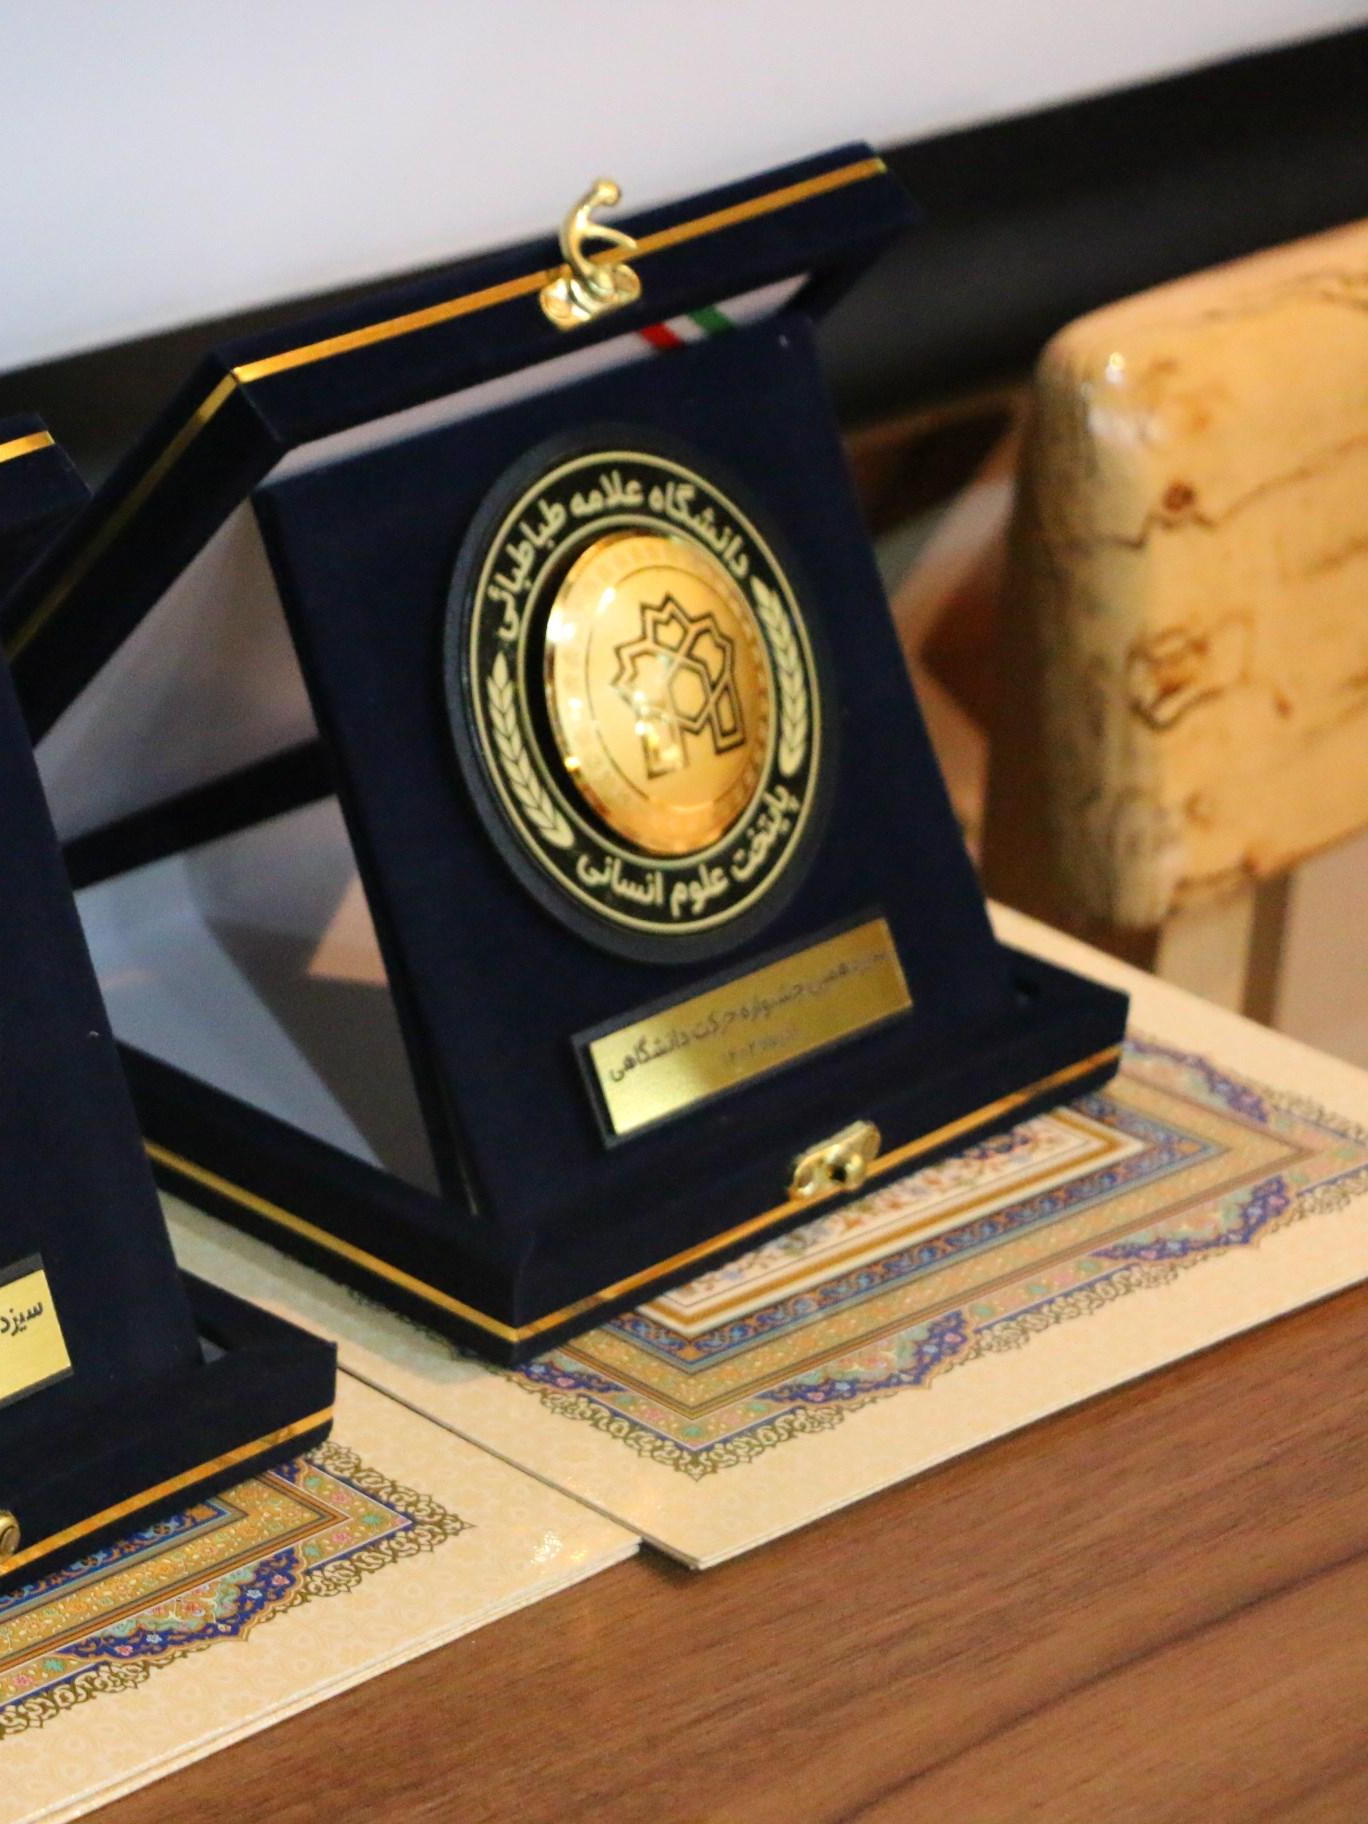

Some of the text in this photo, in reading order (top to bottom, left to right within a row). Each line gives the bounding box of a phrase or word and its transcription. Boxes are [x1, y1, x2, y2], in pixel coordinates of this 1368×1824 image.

[570, 470, 644, 516] علامه
[649, 481, 750, 577] دانشگاه
[576, 785, 800, 919] پایتخت علوم انسانی
